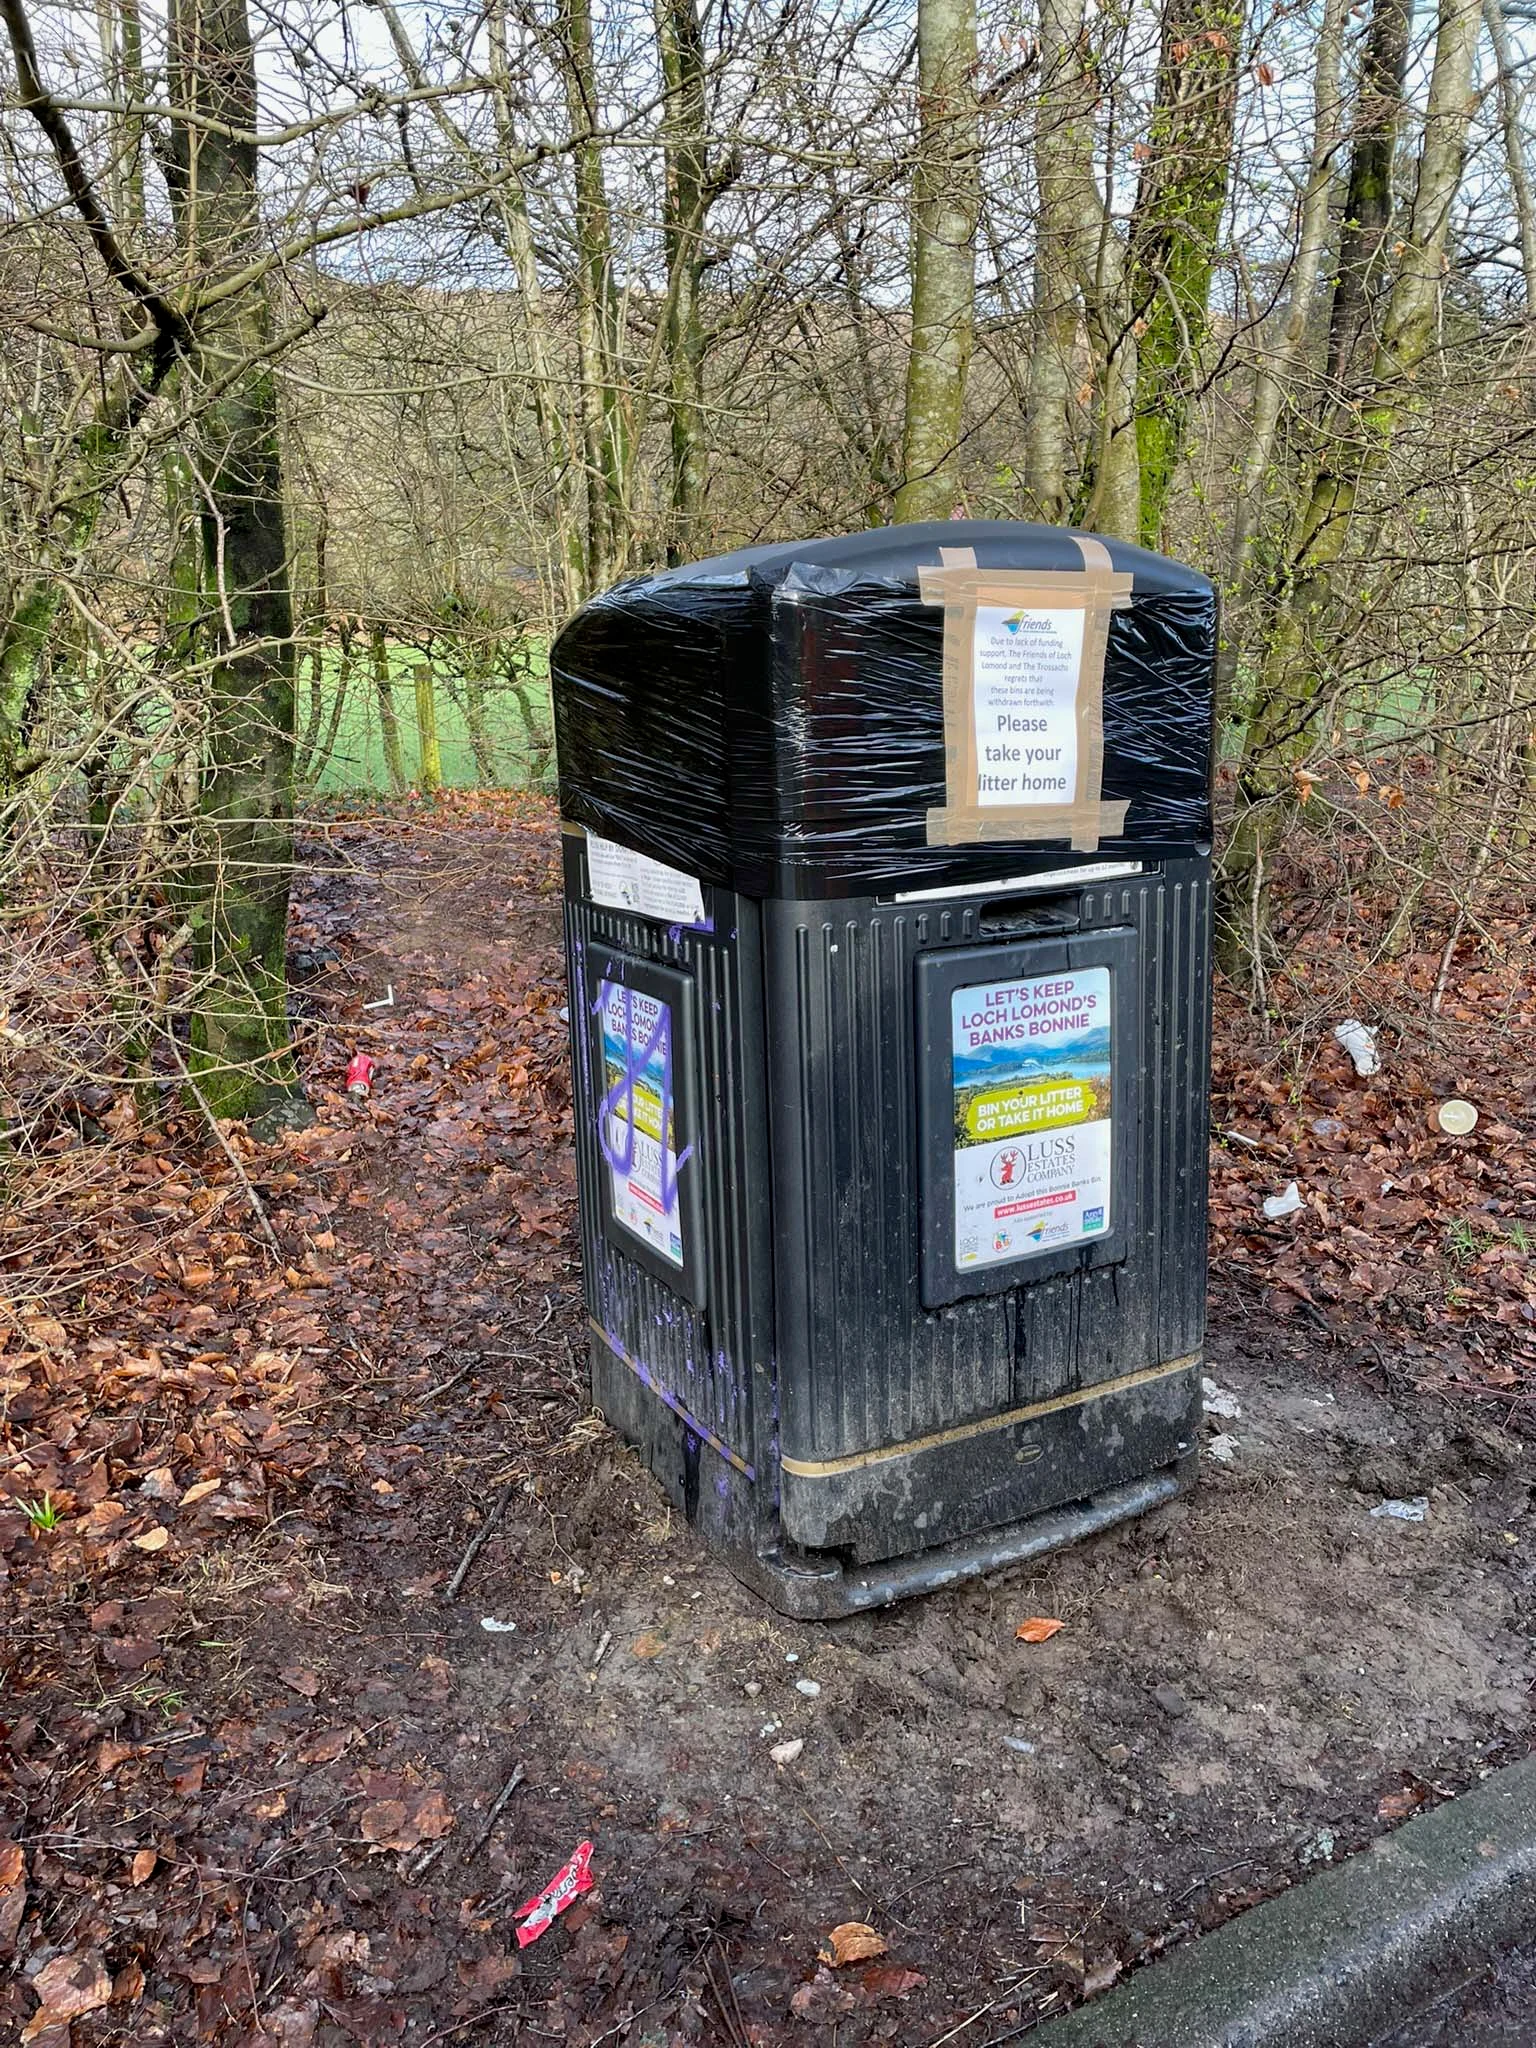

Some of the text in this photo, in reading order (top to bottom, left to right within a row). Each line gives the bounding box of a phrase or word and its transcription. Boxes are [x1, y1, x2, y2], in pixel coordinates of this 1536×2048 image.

[1016, 614, 1052, 634] friends
[990, 637, 1063, 648] Due to lack of funding
[1009, 650, 1021, 658] The
[1023, 650, 1047, 659] Friends
[1048, 651, 1056, 659] of
[1057, 651, 1072, 660] Loch
[981, 662, 1068, 671] Lomond and The Trossachs
[1004, 674, 1043, 684] regrets that
[990, 686, 1008, 695] these
[1009, 686, 1023, 695] bins
[1036, 687, 1054, 696] being
[988, 698, 1022, 706] withdrawn
[997, 714, 1048, 732] Please
[985, 744, 1062, 765] take your
[978, 772, 1066, 791] litter home
[985, 980, 1075, 1008] LET'S KEEP
[639, 999, 658, 1016] KEEP
[961, 994, 1097, 1030] LOCH LOMOND'S
[970, 1013, 1090, 1047] BANKS BONNIE
[977, 1086, 1082, 1118] BIN YOUR LITTER
[976, 1100, 1084, 1132] OR TAKE IT HOME
[1027, 1135, 1076, 1162] LUSS
[1027, 1153, 1076, 1173] ESTATES
[1027, 1164, 1076, 1184] COMPANY
[963, 1204, 974, 1212] We
[975, 1202, 985, 1210] are
[986, 1197, 1006, 1209] proud
[1007, 1195, 1015, 1203] to
[1015, 1190, 1036, 1202] Adopt
[1036, 1187, 1048, 1196] this
[1048, 1183, 1071, 1194] Bonnie
[1071, 1179, 1090, 1189] Banks
[997, 1193, 1074, 1216] www.lussestates.co.uk
